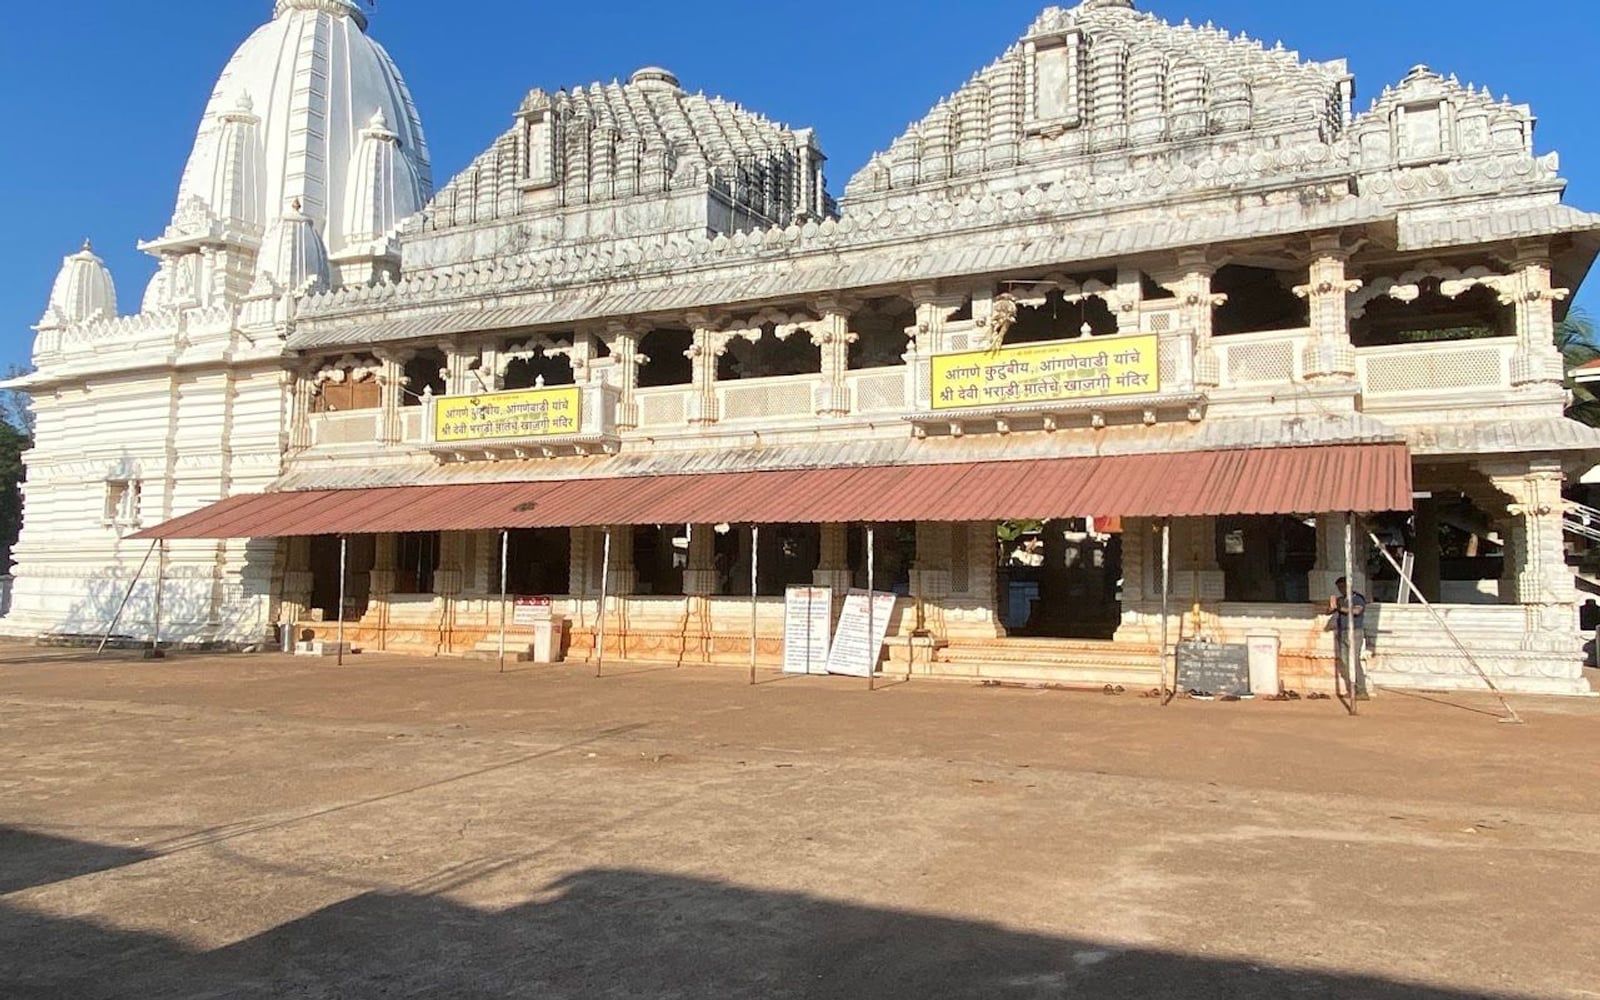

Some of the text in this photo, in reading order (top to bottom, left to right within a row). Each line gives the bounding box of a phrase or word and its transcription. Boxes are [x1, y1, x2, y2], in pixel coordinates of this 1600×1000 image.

[945, 364, 981, 380] आंगणे
[1040, 351, 1108, 371] आंगणेवाडी
[1113, 348, 1141, 365] यांचे
[940, 386, 954, 401] श्री
[958, 384, 979, 400] देवी
[983, 381, 1019, 397] भराडी
[1064, 373, 1111, 391] खाजगी
[1116, 371, 1150, 387] मंदिर
